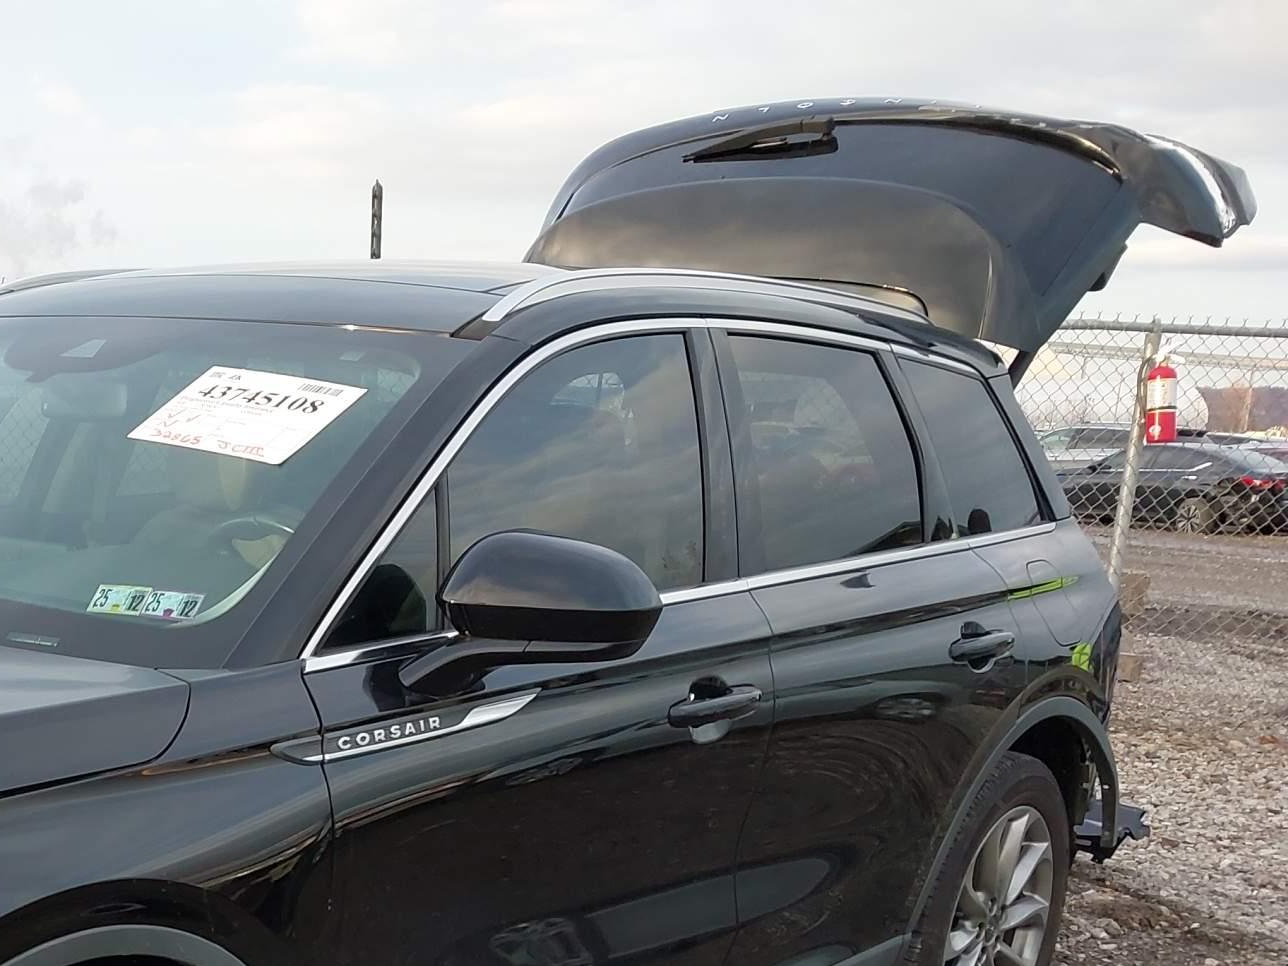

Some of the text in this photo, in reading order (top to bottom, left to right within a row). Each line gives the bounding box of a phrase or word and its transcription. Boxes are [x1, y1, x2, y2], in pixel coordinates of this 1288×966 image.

[198, 384, 325, 415] 43745108
[93, 589, 145, 611] 25 12
[145, 593, 197, 617] 25 12
[337, 716, 442, 750] CORSAIR
